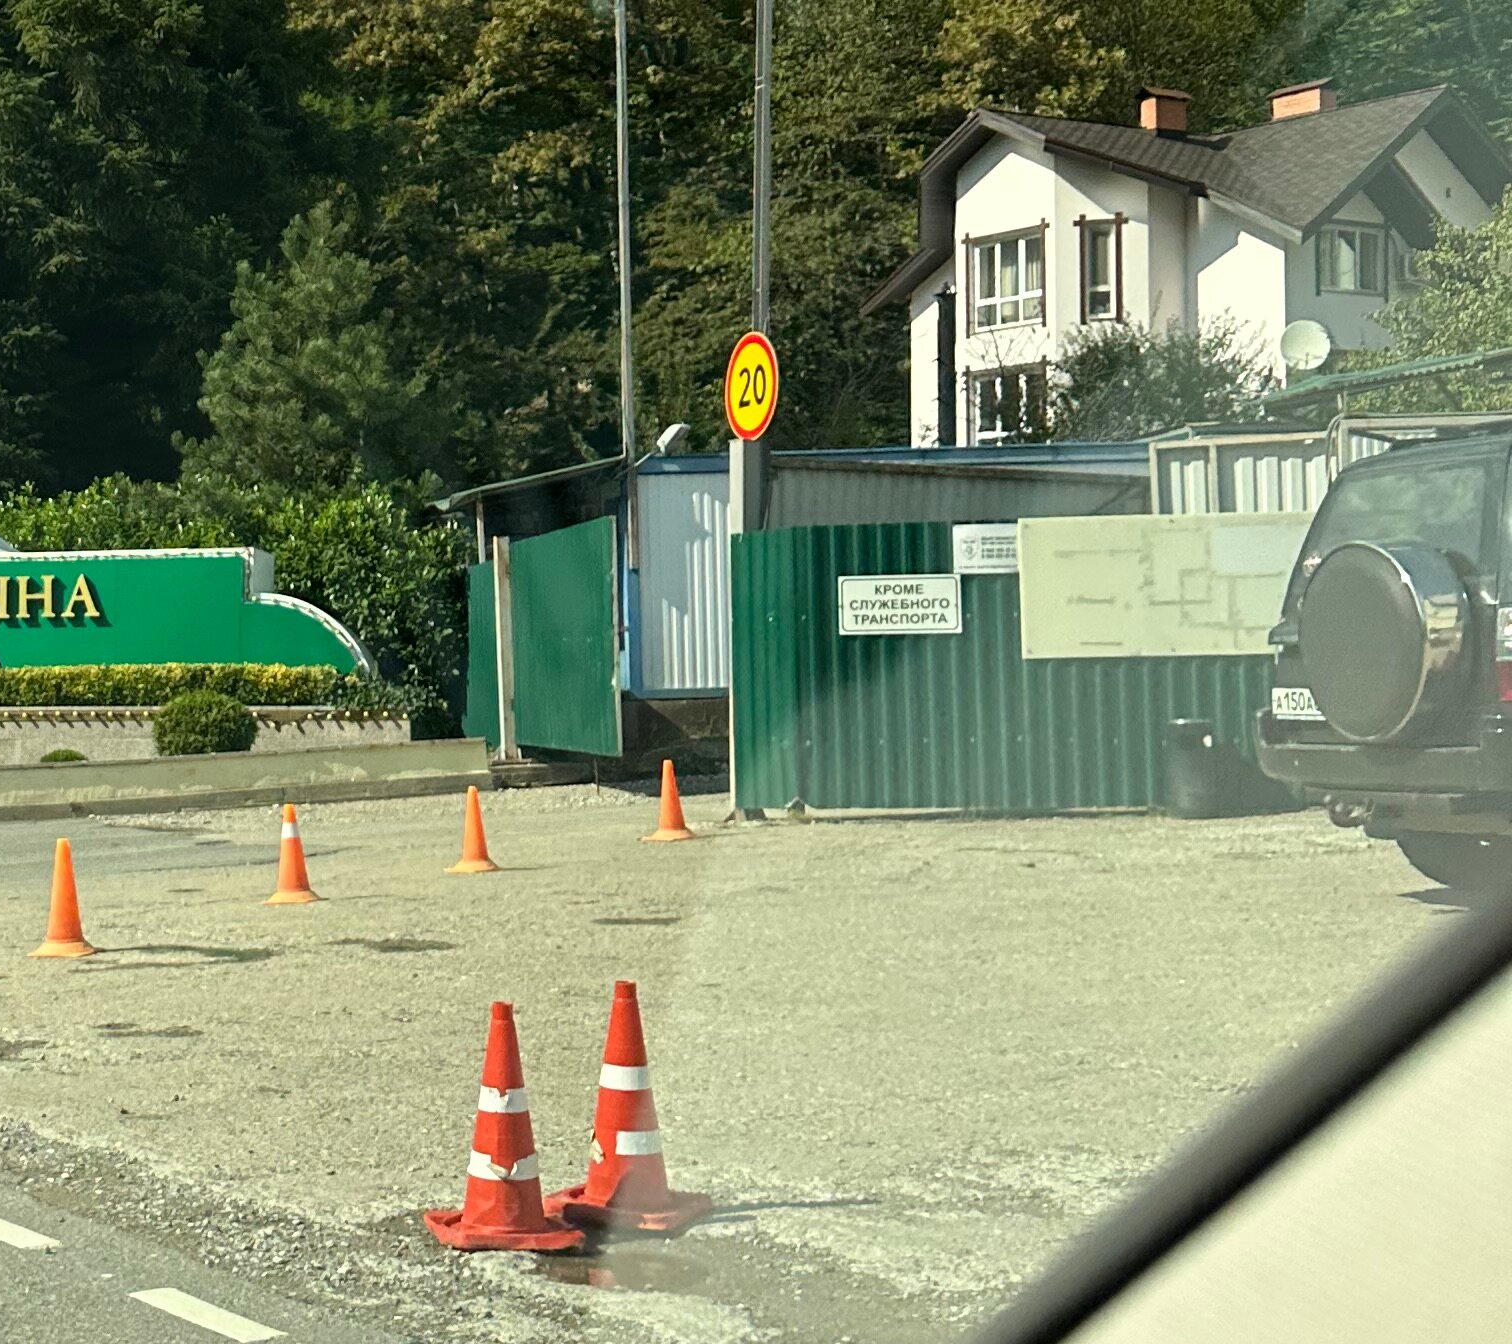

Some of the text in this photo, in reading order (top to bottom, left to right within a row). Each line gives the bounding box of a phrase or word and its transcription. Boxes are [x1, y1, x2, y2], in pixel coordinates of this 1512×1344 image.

[738, 364, 766, 408] 20
[874, 584, 924, 595] КРОМЕ
[849, 598, 950, 611] СЛУЖЕБНОГО
[853, 613, 948, 625] ТРАНСПОРТА
